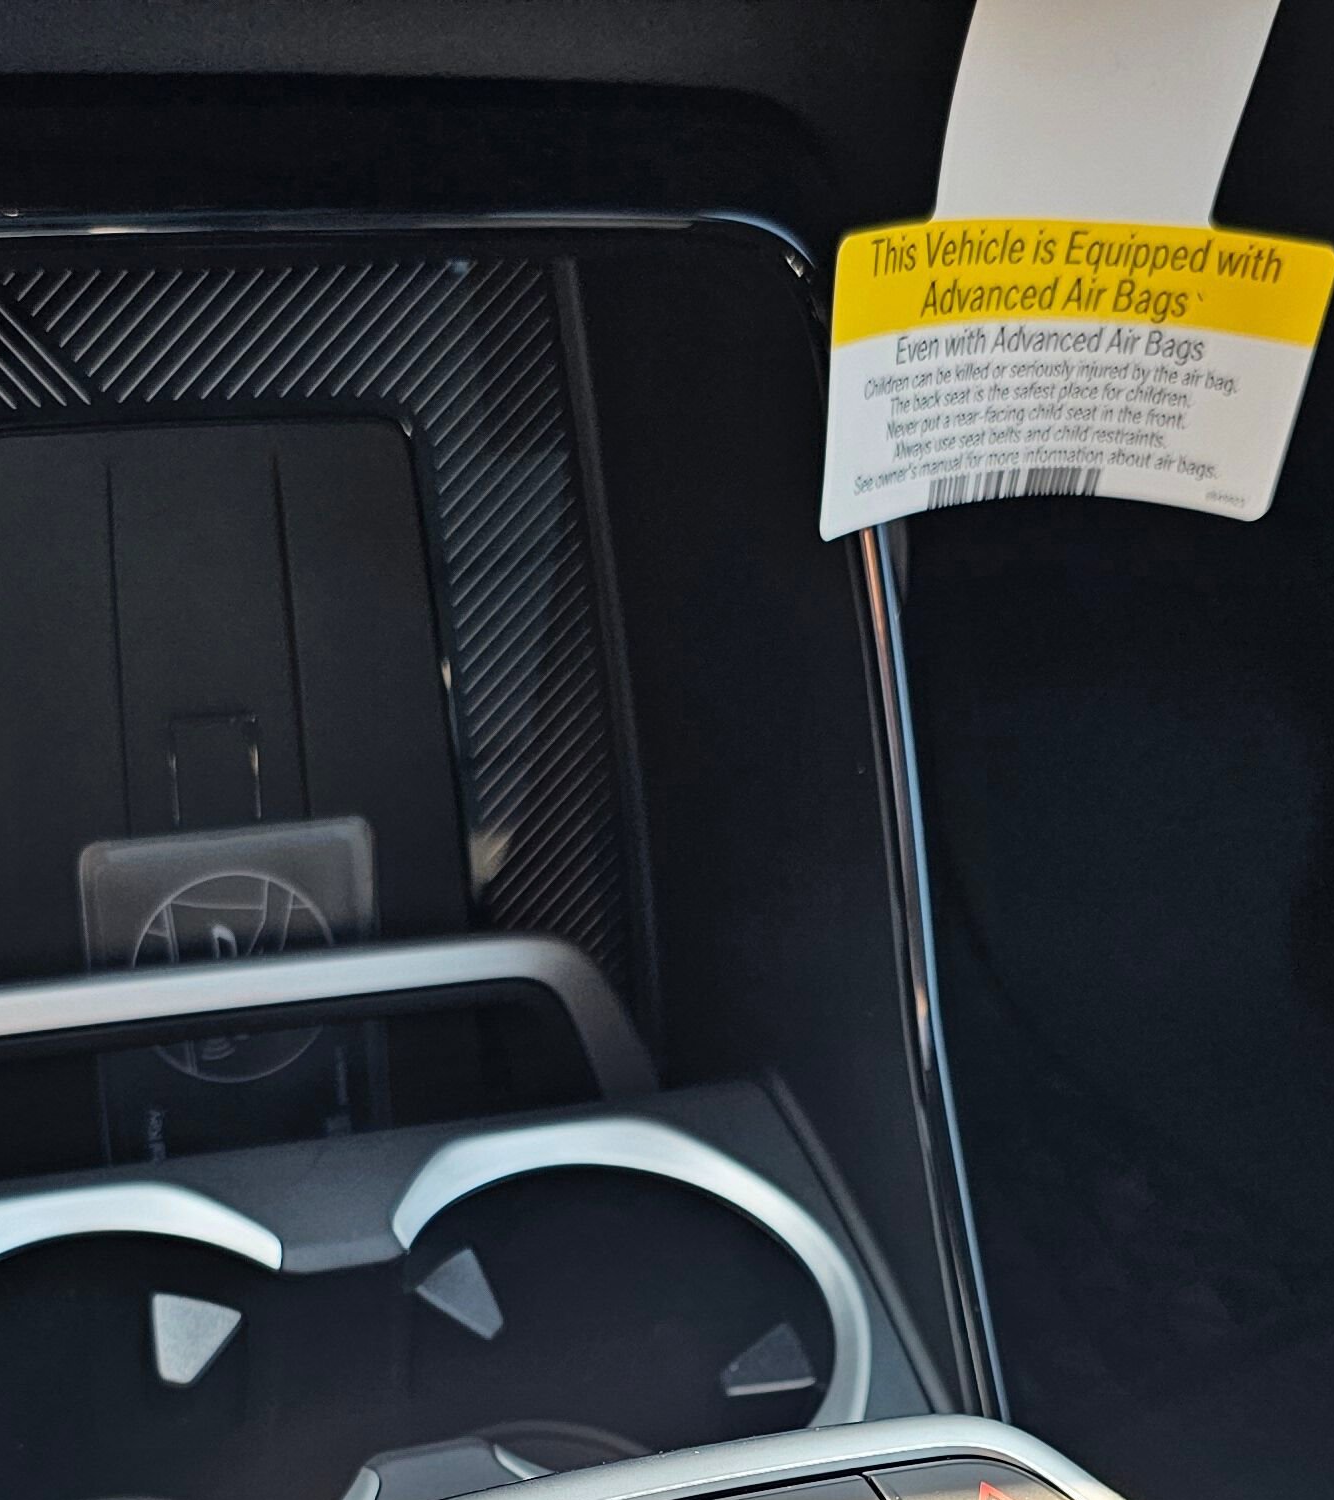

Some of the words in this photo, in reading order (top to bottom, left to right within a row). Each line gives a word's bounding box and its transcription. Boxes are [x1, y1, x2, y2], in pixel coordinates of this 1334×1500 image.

[872, 233, 916, 277] This
[926, 229, 1025, 269] Vehicle
[1033, 230, 1057, 265] is
[1064, 231, 1215, 277] Equipped
[1218, 242, 1282, 284] with
[921, 277, 1059, 318] Advanced
[1061, 277, 1107, 312] Air
[1112, 279, 1188, 324] Bags
[895, 336, 939, 365] Even
[945, 326, 986, 357] with
[990, 324, 1107, 354] Advanced
[1104, 327, 1141, 355] Air
[1145, 330, 1205, 366] Bags
[864, 374, 909, 399] Children
[911, 371, 932, 387] can
[936, 366, 952, 385] be
[955, 362, 989, 382] killed
[992, 364, 1006, 378] or
[1010, 360, 1075, 381] seriously
[1078, 361, 1127, 382] injured
[1132, 363, 1152, 385] by
[1153, 365, 1178, 384] the
[1181, 369, 1203, 387] air
[890, 396, 911, 416] The
[912, 391, 940, 411] back
[944, 387, 970, 405] seat
[974, 387, 984, 402] is
[988, 383, 1009, 400] the
[1013, 381, 1054, 398] safest
[1058, 382, 1099, 400] place
[1102, 383, 1123, 401] for
[886, 419, 918, 441] Never
[920, 415, 940, 436] put
[953, 406, 1024, 428] rear-facing
[1027, 402, 1064, 421] child
[1067, 405, 1096, 421] seat
[1099, 404, 1114, 422] in
[1117, 405, 1142, 424] the
[893, 440, 931, 462] Always
[935, 436, 956, 451] use
[959, 431, 984, 448] seat
[988, 426, 1021, 443] belts
[1027, 426, 1051, 443] and
[1054, 425, 1092, 442] child
[854, 474, 873, 496] See
[876, 464, 917, 488] owner's
[919, 454, 963, 475] manual
[967, 454, 983, 468] for
[987, 452, 1018, 467] more
[1024, 446, 1104, 466] information
[1107, 449, 1151, 468] about
[1154, 454, 1177, 472] air
